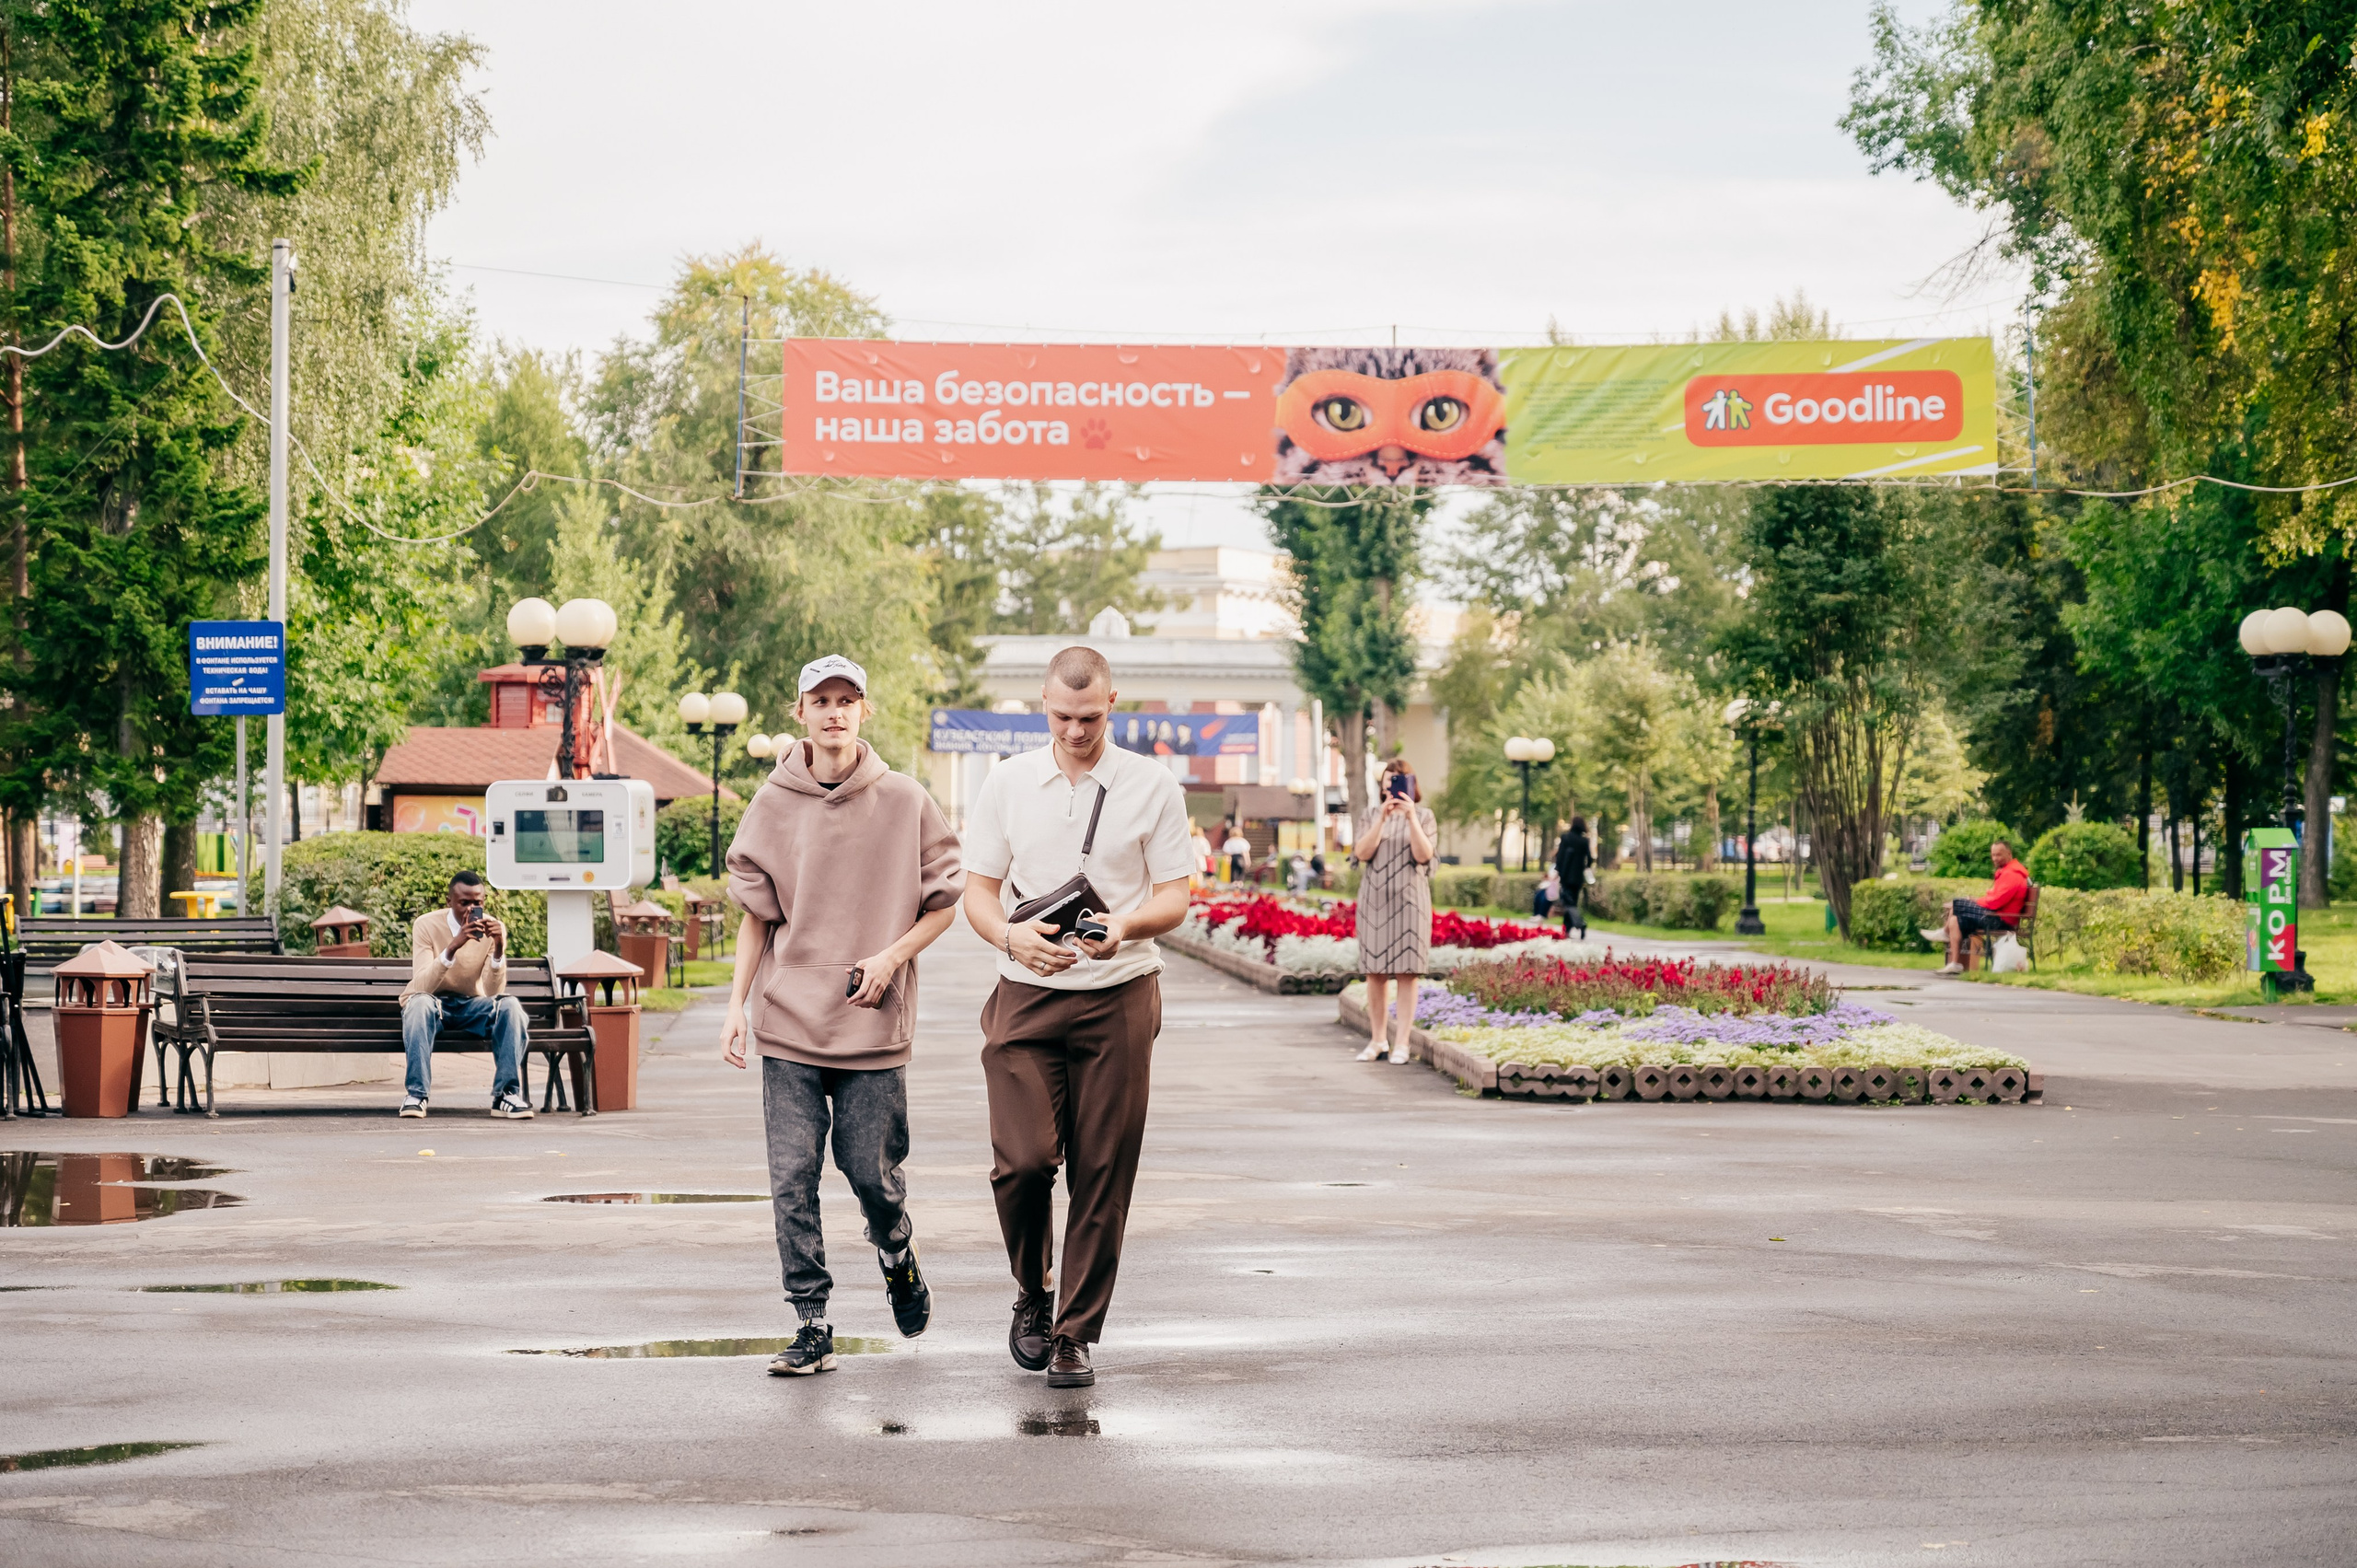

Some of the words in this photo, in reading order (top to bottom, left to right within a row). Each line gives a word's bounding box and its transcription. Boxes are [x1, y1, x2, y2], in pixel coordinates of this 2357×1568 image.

[815, 369, 925, 405] Ваша
[934, 369, 1216, 408] безопасность
[1765, 384, 1945, 425] Goodline
[815, 416, 923, 443] наша
[934, 410, 1071, 446] забота
[196, 636, 278, 649] ВНИМАНИЕ!
[201, 656, 230, 665] ФОНТАНЕ
[230, 656, 278, 665] ИСПОЛЬЗУЕТСЯ
[249, 667, 269, 675] ВОДА!
[2268, 850, 2286, 961] КОРМ
